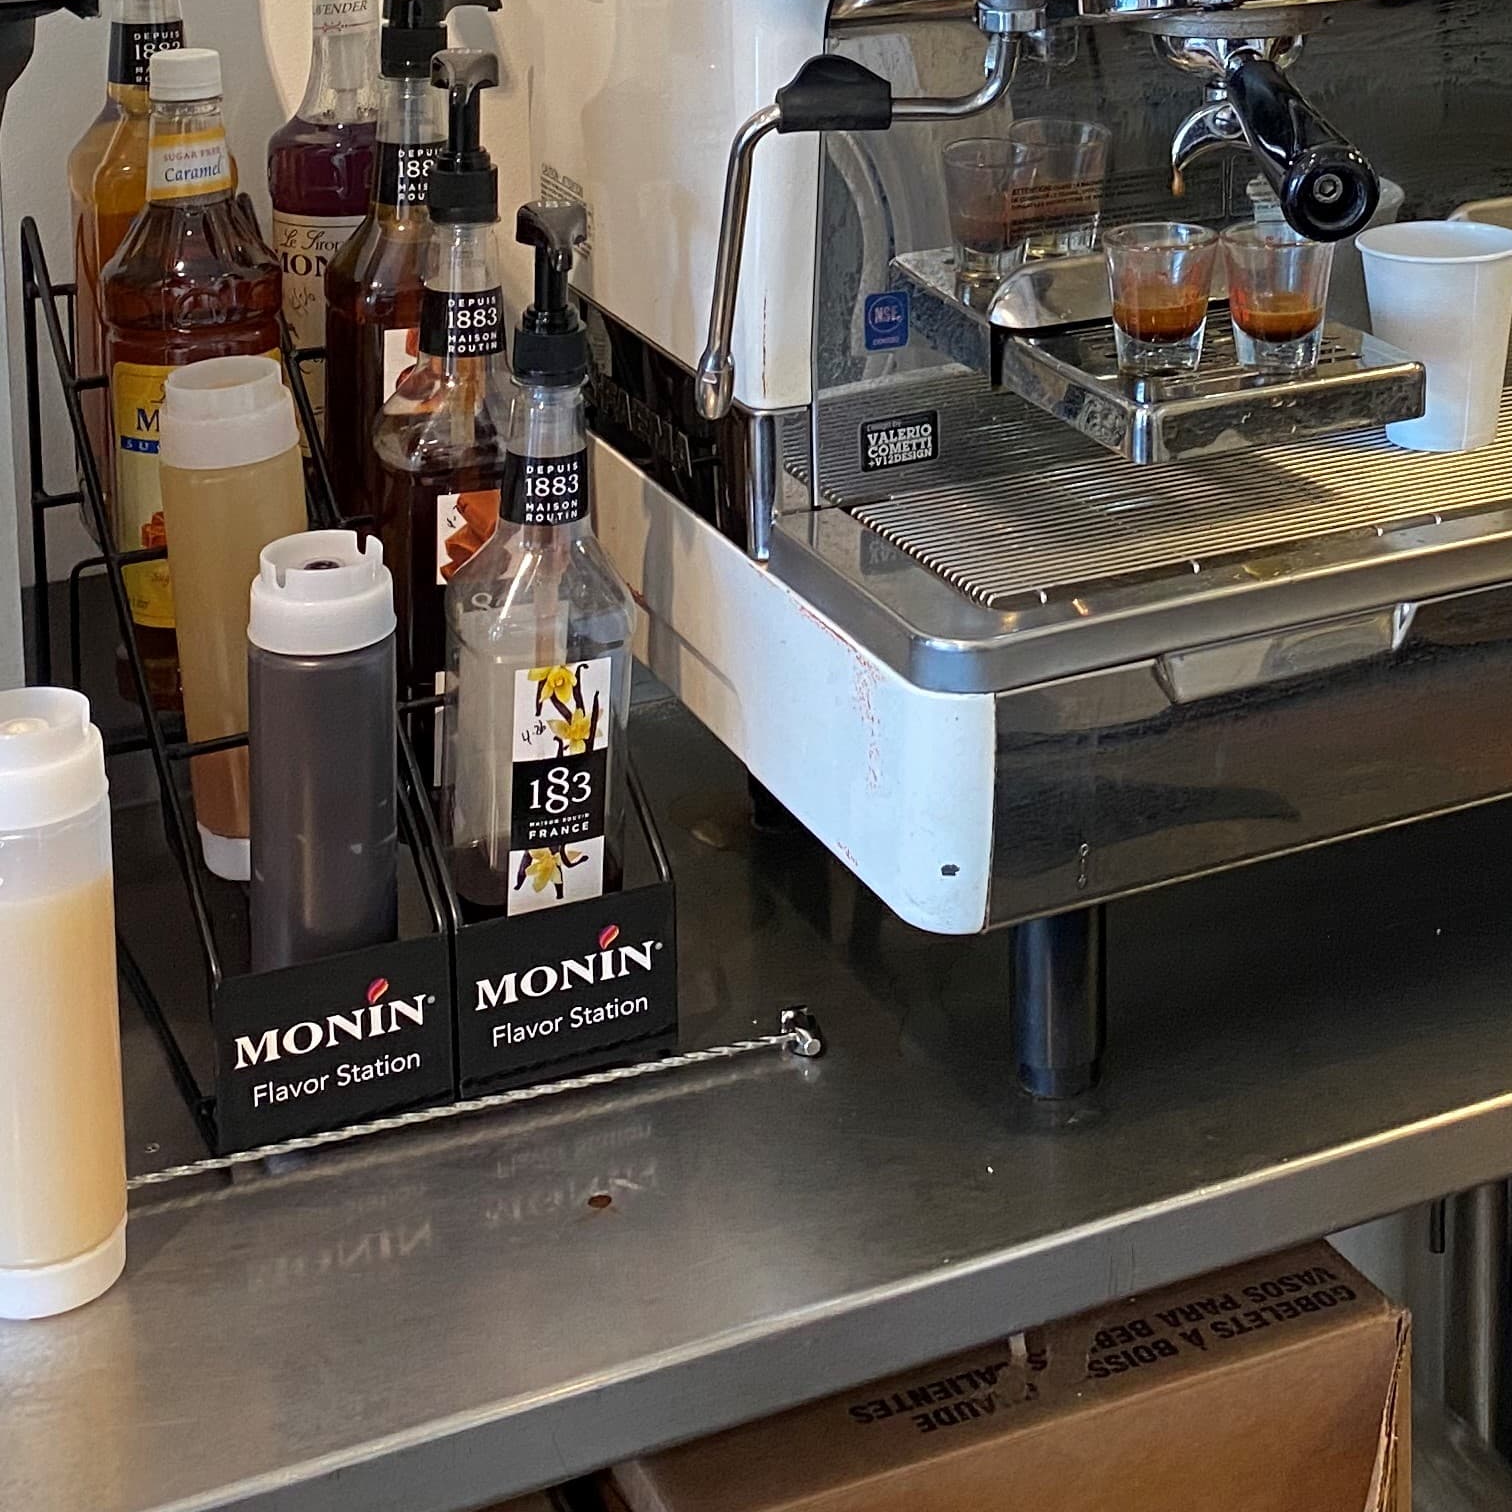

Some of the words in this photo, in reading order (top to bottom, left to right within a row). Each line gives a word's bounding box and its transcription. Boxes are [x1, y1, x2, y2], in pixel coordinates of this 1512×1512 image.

[134, 31, 180, 41] DEPUIS
[164, 156, 222, 183] Caramel
[280, 229, 298, 249] Le
[448, 296, 496, 308] DEPUIS
[448, 307, 497, 330] 1883
[448, 332, 496, 344] MAISON
[448, 341, 497, 354] ROUTIN
[867, 424, 931, 447] VALERIO
[868, 437, 932, 459] COMETTI
[526, 462, 579, 475] DEPUIS
[525, 475, 579, 497] 1883
[526, 499, 578, 512] MAISON
[526, 509, 578, 523] ROUTIN
[528, 821, 590, 841] FRANCE
[475, 924, 655, 1011] MONIN
[234, 978, 427, 1070] MONIN
[492, 1017, 563, 1048] Flavor
[569, 994, 649, 1029] Station
[253, 1074, 330, 1108] Flavor
[336, 1051, 421, 1086] Station
[1241, 1266, 1337, 1305] VASOS
[1154, 1292, 1242, 1328] PARA
[1208, 1284, 1358, 1340] GOBELETS
